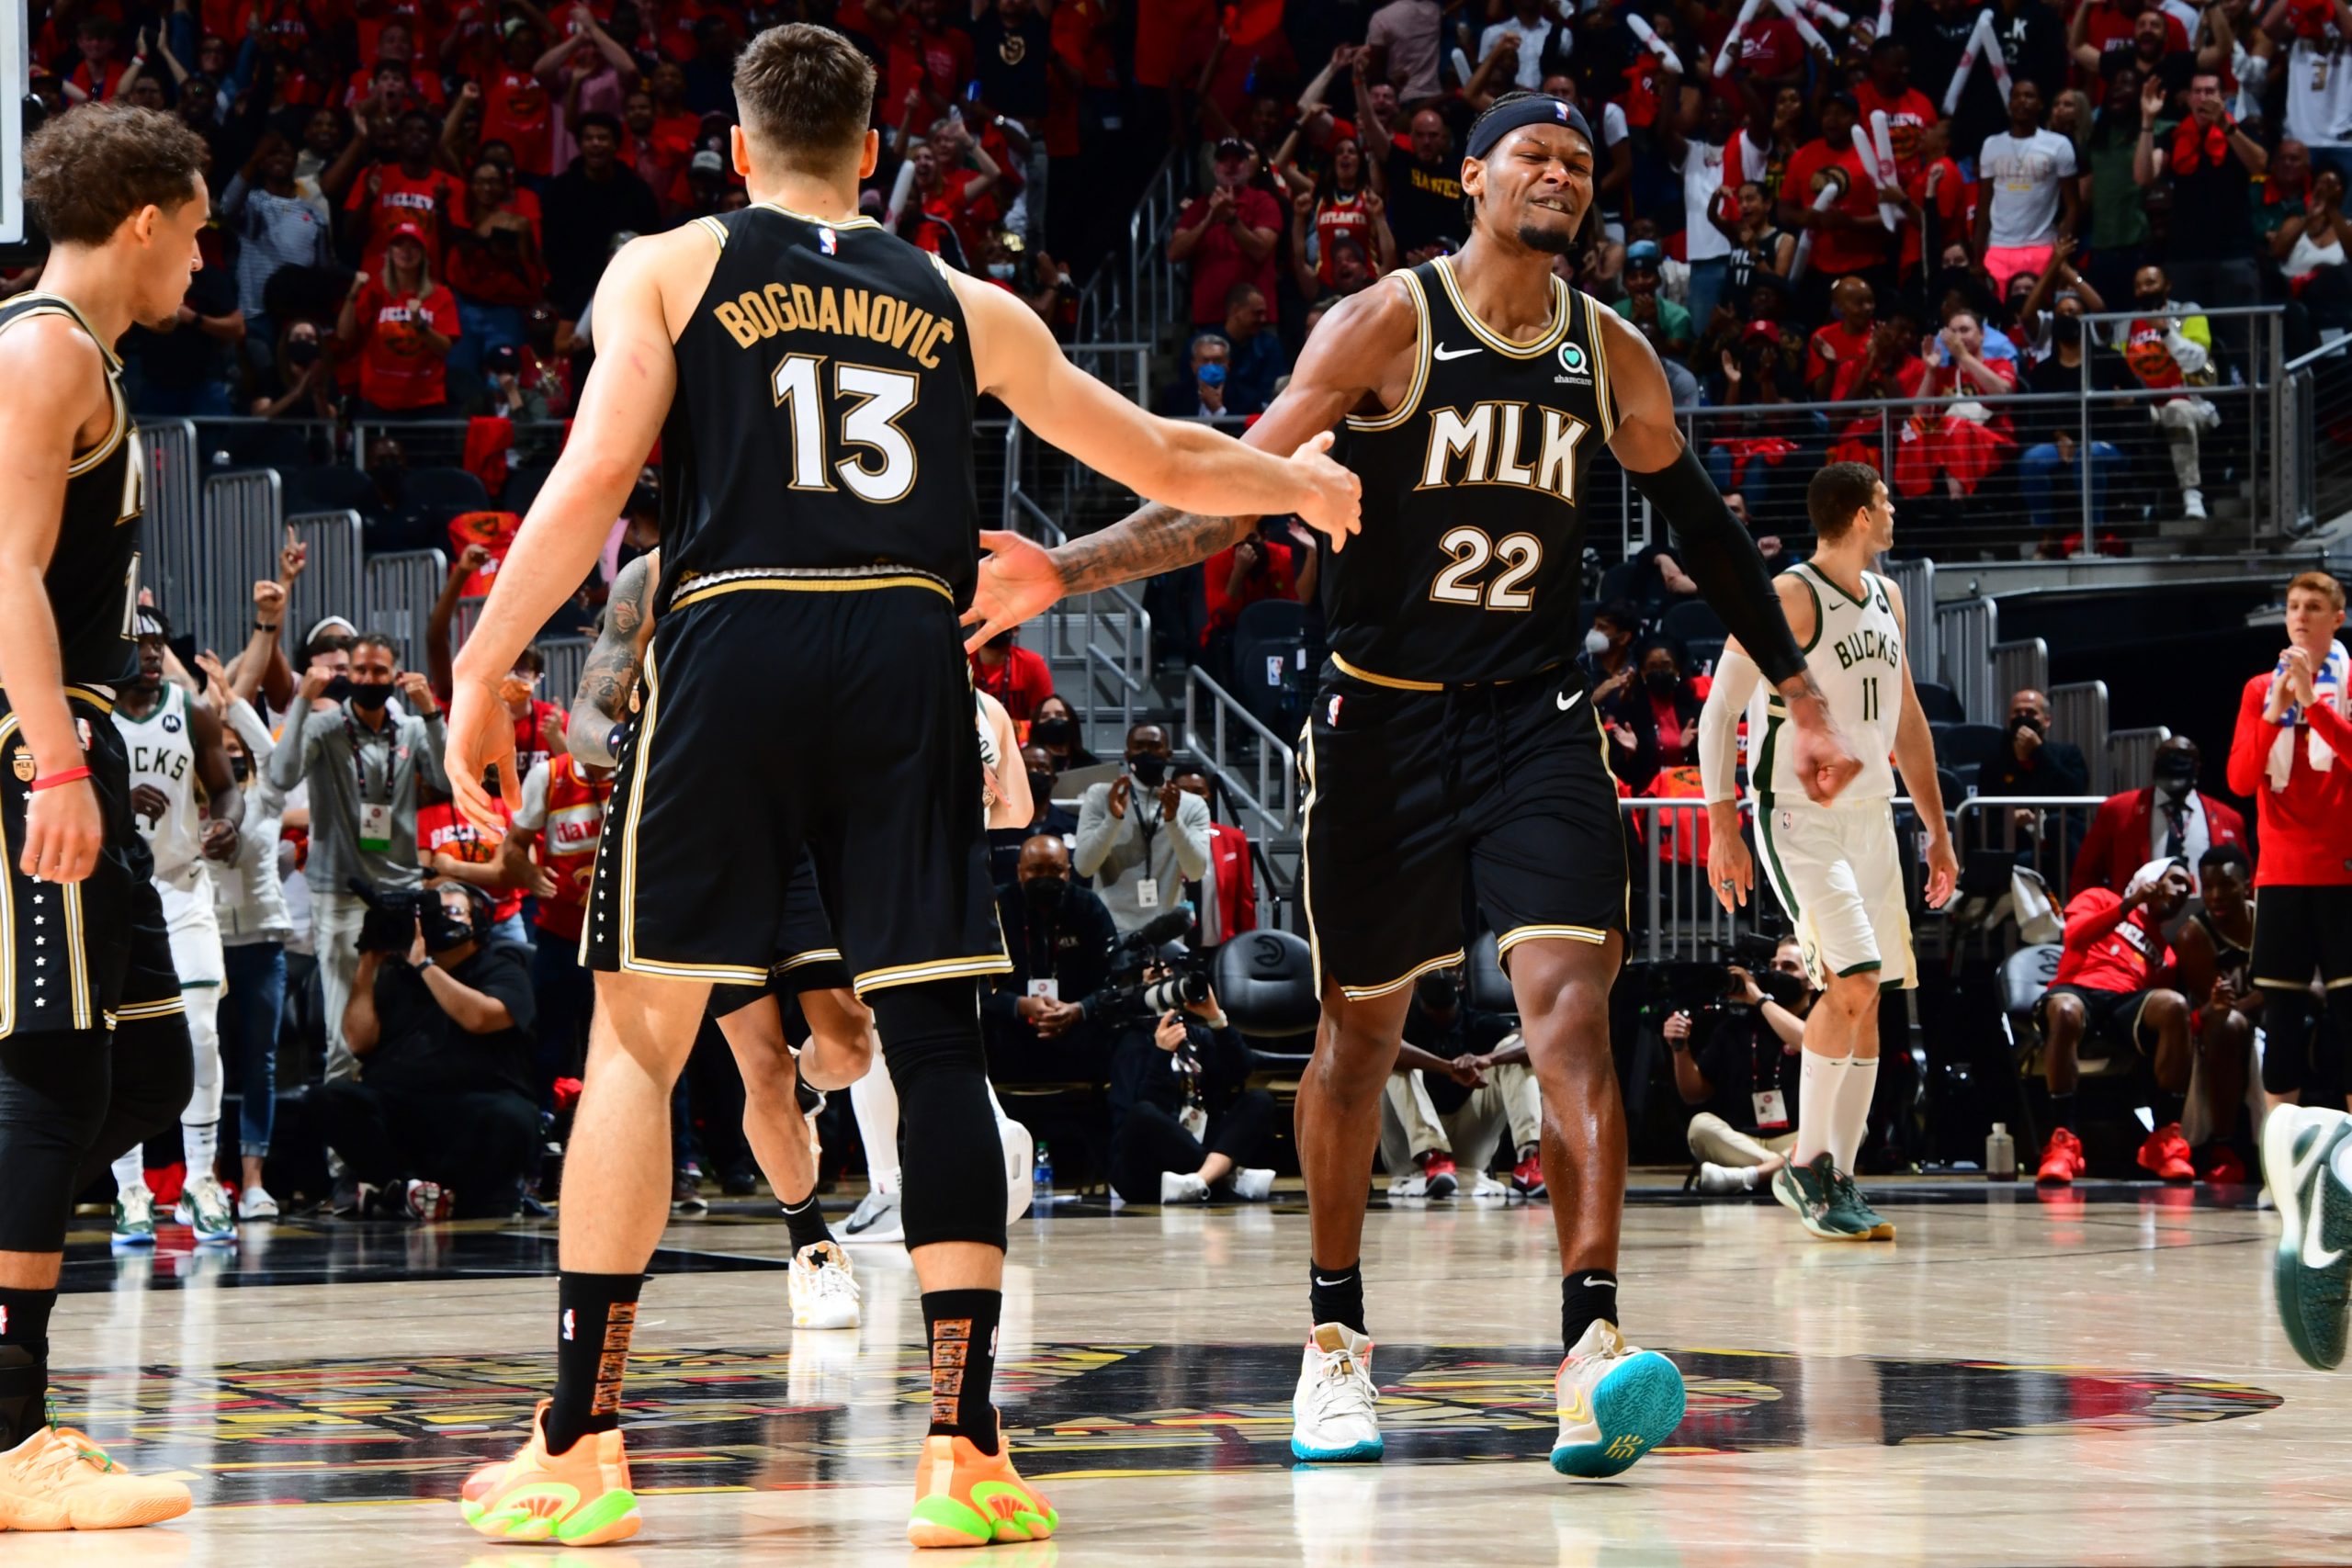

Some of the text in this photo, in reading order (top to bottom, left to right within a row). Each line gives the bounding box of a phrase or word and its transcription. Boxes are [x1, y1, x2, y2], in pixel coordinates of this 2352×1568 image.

[1411, 168, 1463, 199] HAWKS
[1319, 211, 1367, 225] ATLANTA
[1555, 374, 1592, 386] sharecare
[771, 353, 920, 503] 13
[1412, 400, 1591, 507] MLK
[1430, 525, 1543, 611] 22
[1834, 630, 1898, 671] BUCKS
[1862, 677, 1878, 721] 11
[134, 747, 187, 781] CKS
